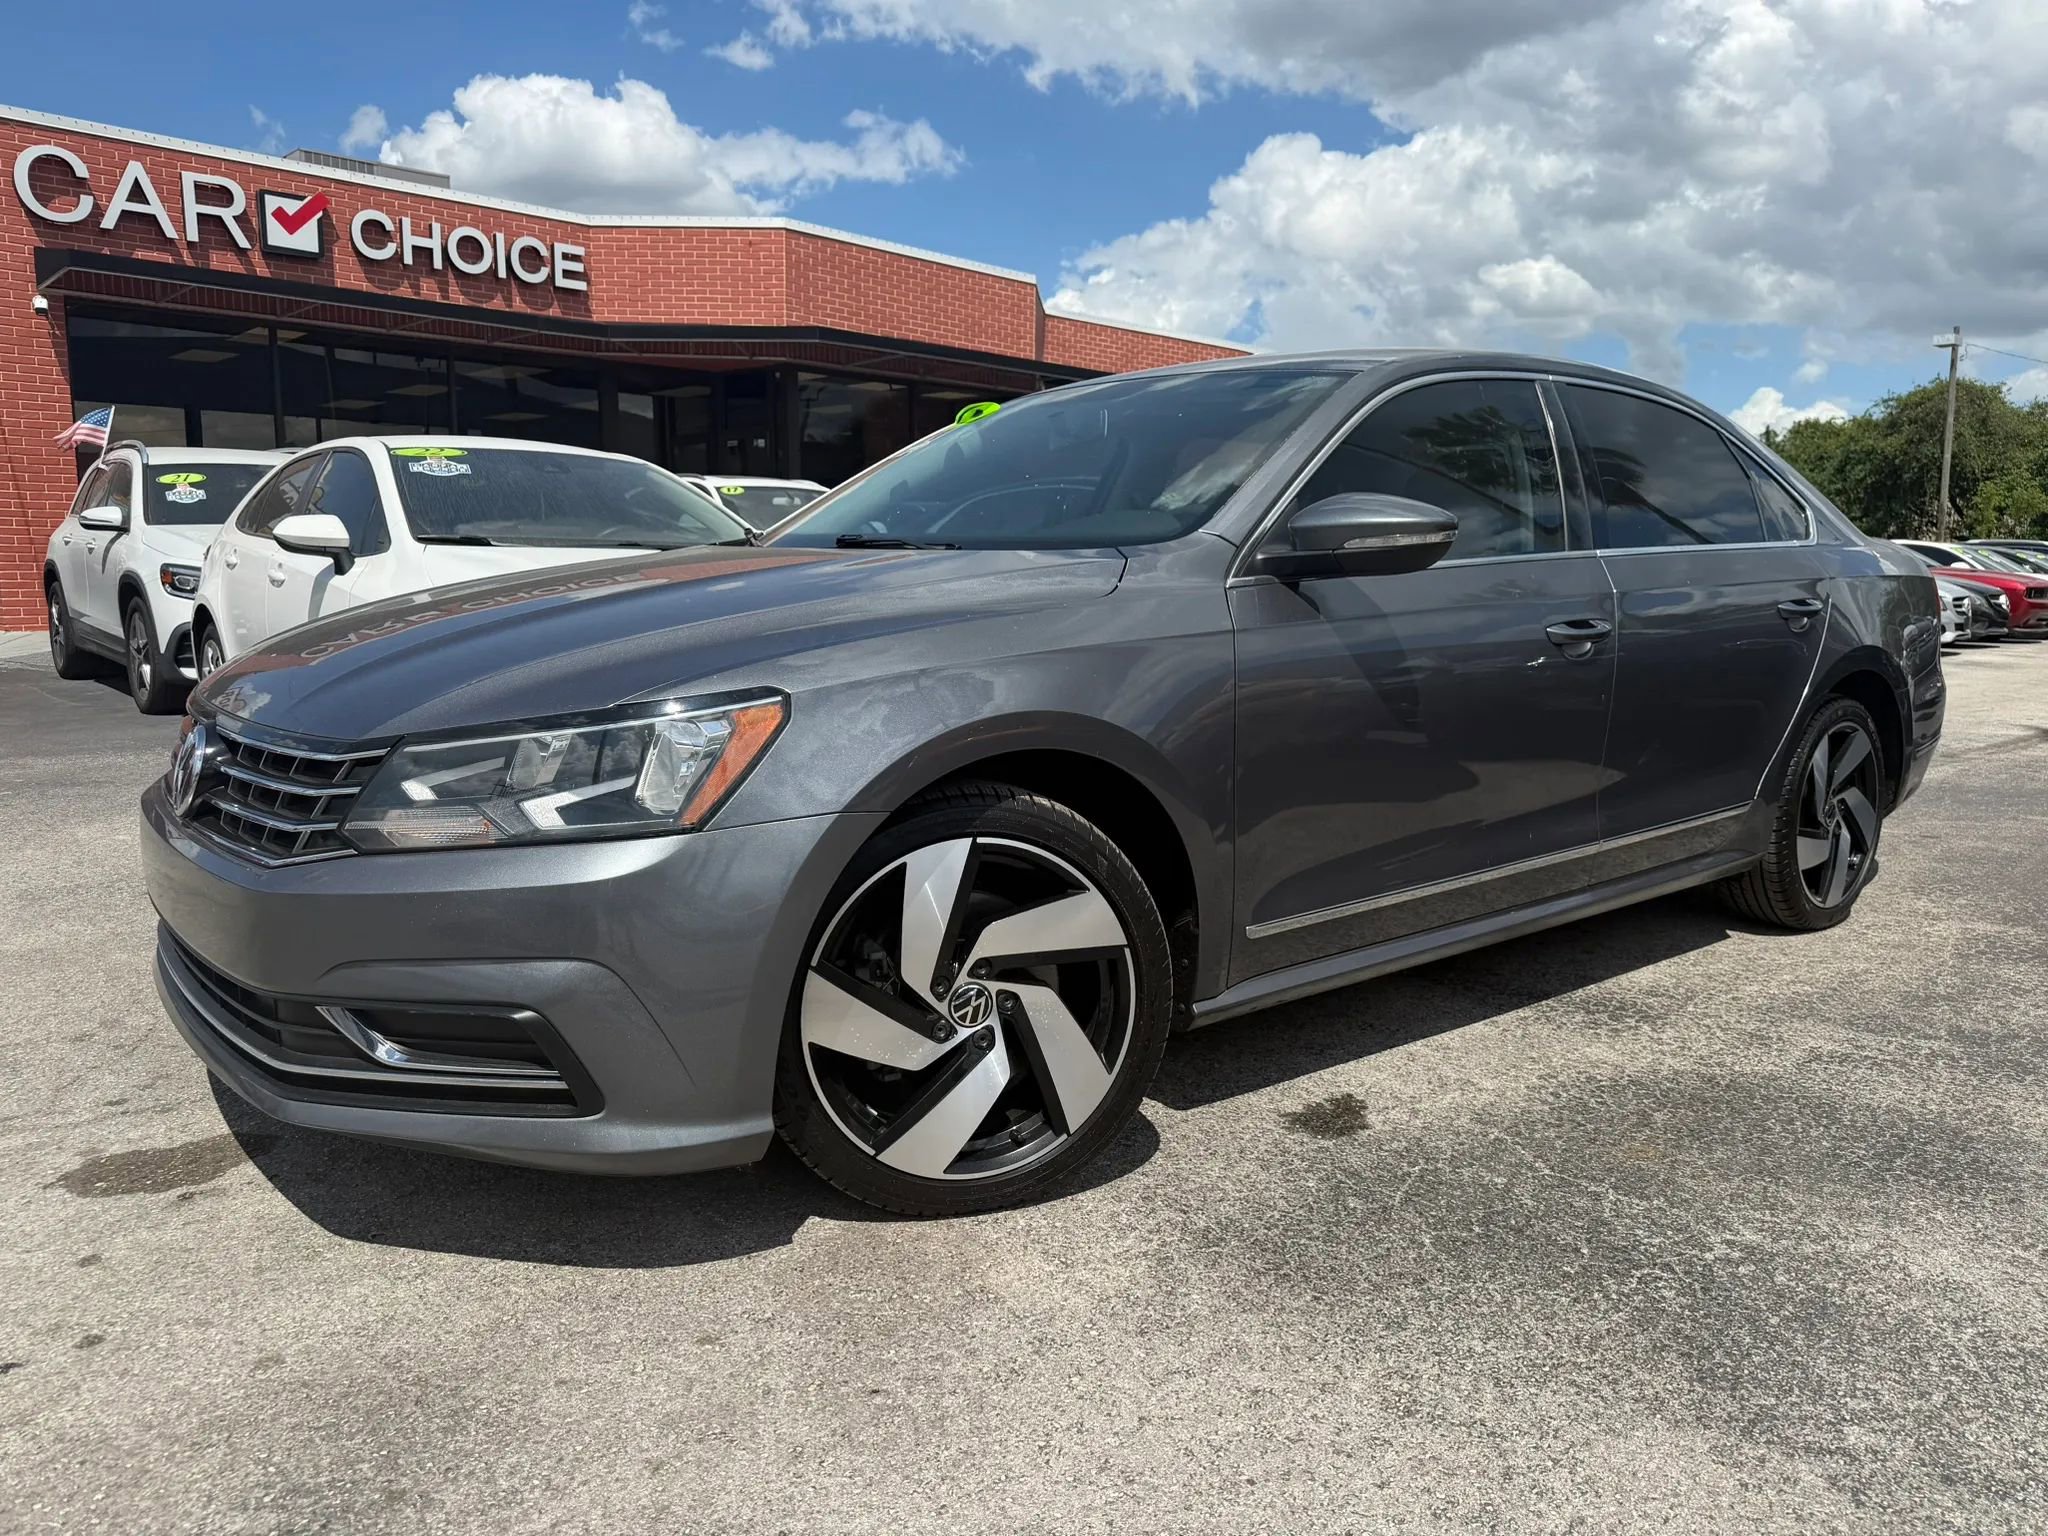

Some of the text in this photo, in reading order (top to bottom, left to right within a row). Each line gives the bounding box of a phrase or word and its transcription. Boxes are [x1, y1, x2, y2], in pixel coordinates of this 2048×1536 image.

[13, 144, 588, 291] CAR CHOICE
[171, 474, 191, 483] 21
